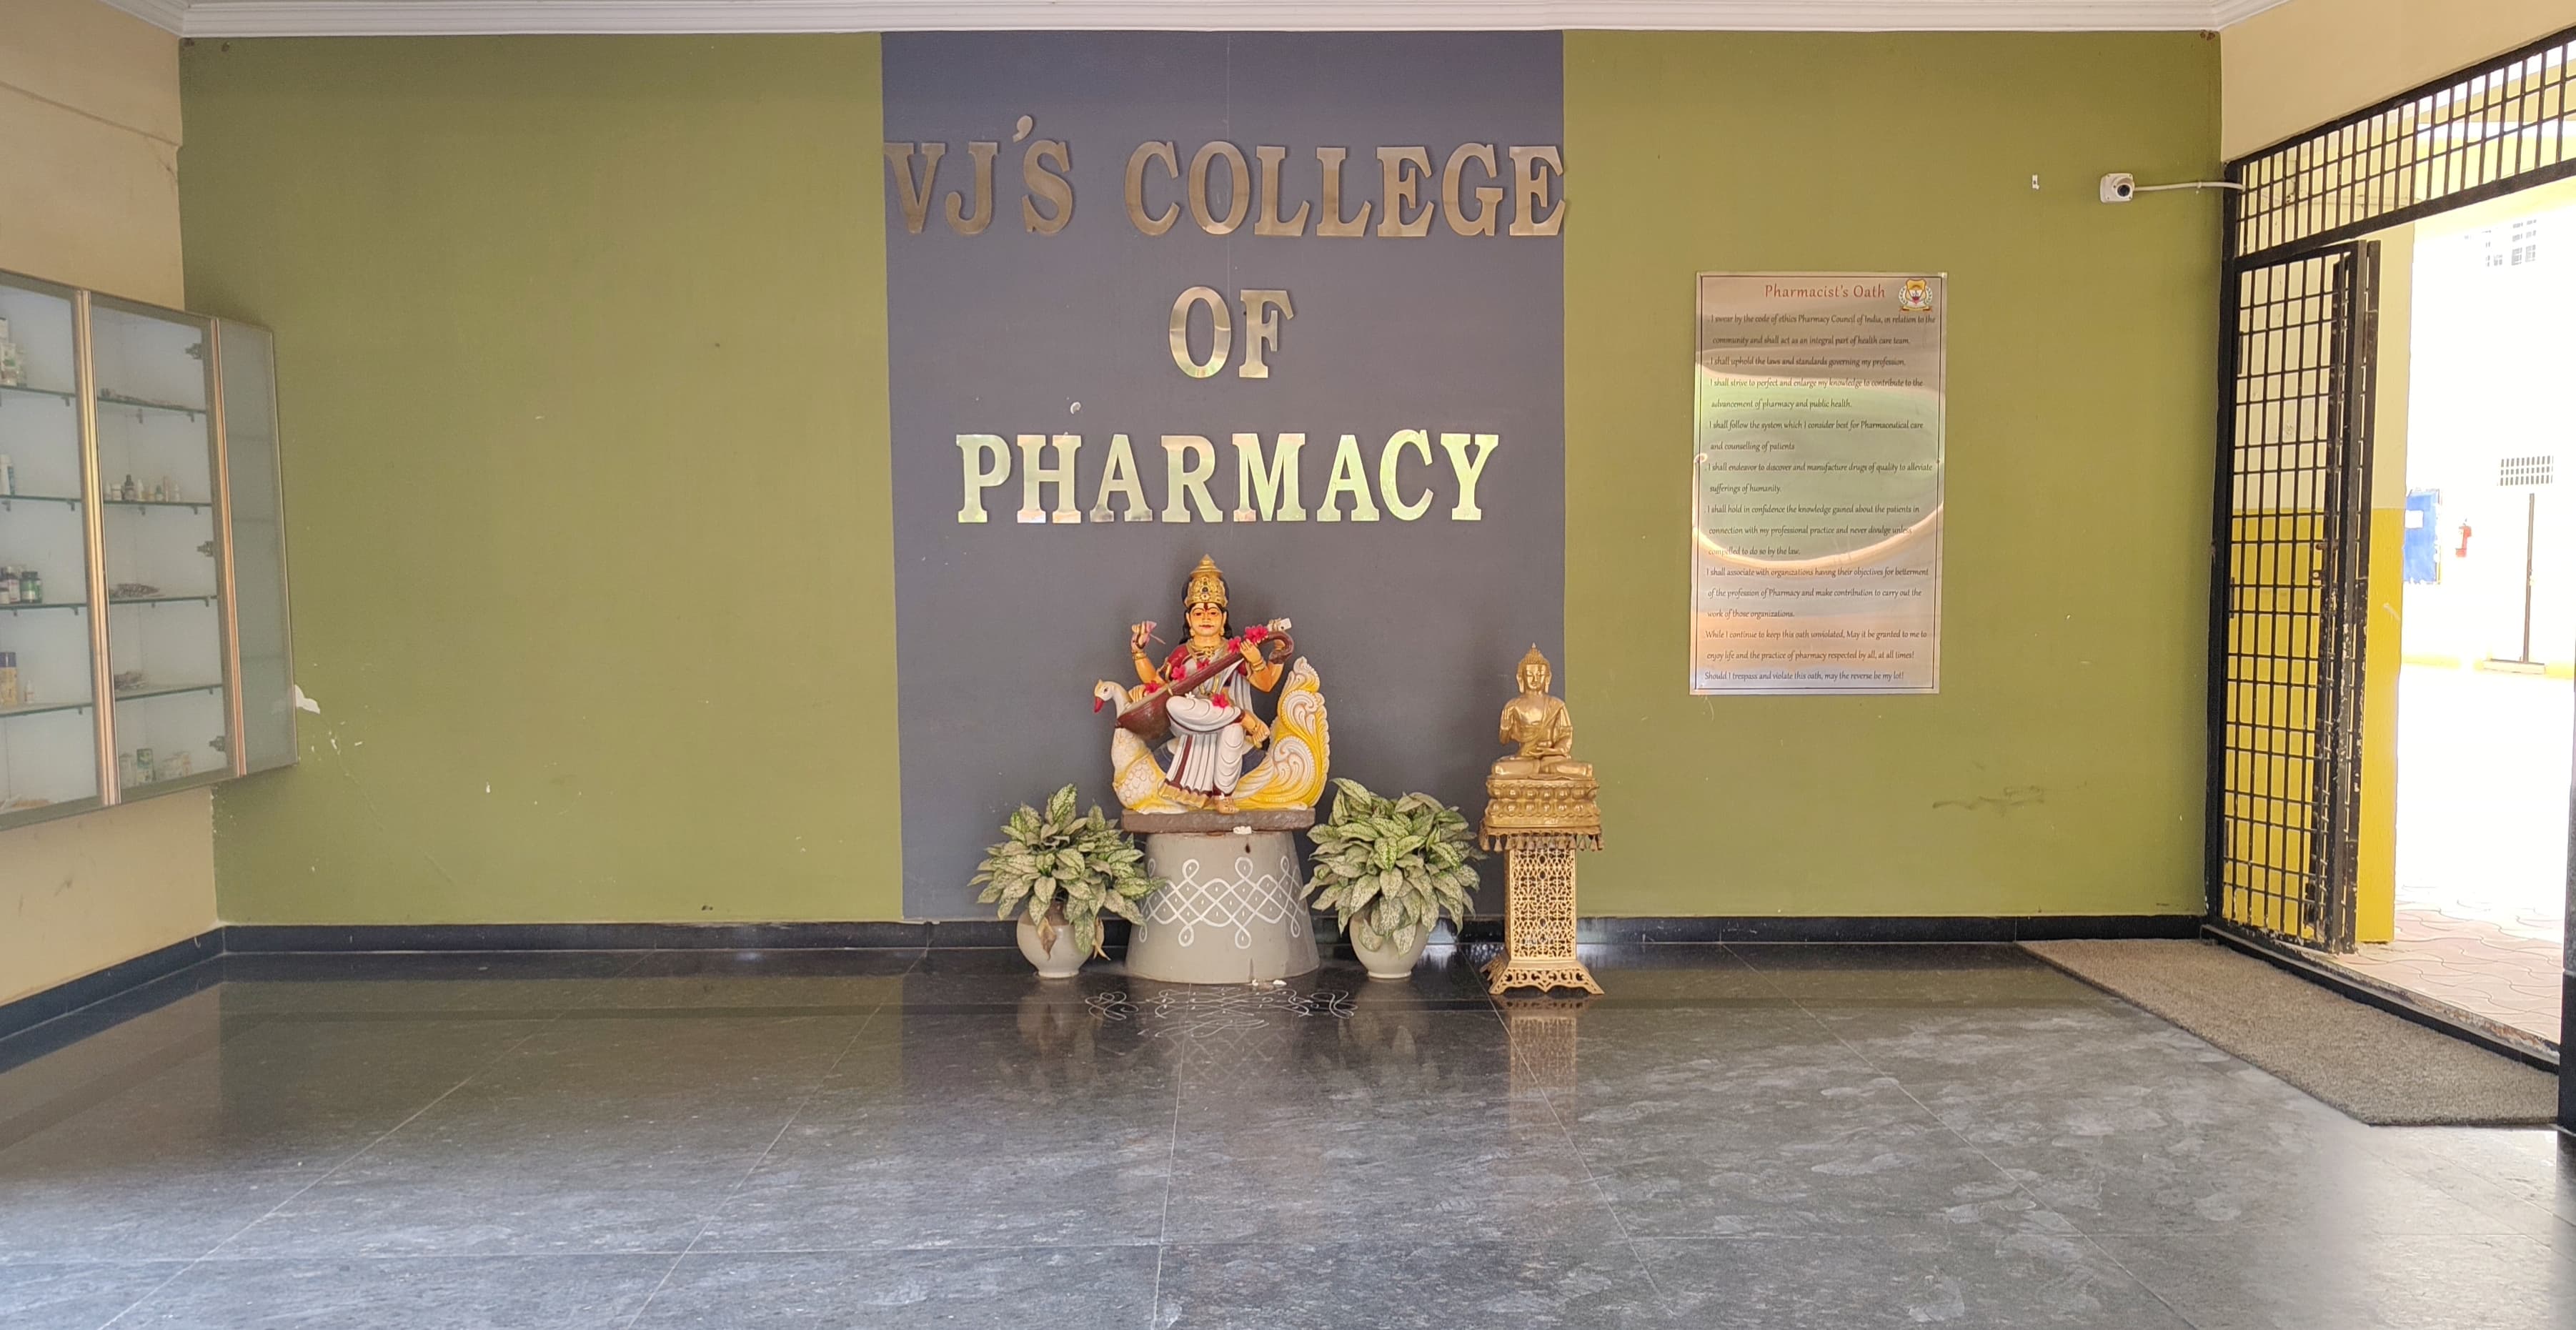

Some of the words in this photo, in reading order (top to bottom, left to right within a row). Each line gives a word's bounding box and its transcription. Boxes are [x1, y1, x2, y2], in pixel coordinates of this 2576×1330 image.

[884, 114, 1074, 237] VJ'S
[1124, 141, 1566, 237] COLLEGE
[1765, 283, 1849, 298] Pharmacist's
[1853, 283, 1886, 298] Oath
[1744, 314, 1754, 323] the
[1755, 314, 1770, 323] code
[1779, 314, 1797, 323] ethics
[1798, 314, 1830, 326] Pharmacy
[1831, 314, 1856, 323] Council
[1892, 314, 1916, 323] relation
[1925, 314, 1935, 323] the
[1168, 286, 1294, 379] OF
[1712, 336, 1749, 347] community
[1750, 334, 1763, 344] and
[1764, 334, 1779, 344] shall
[1809, 334, 1834, 347] integral
[1835, 336, 1849, 347] part
[1858, 334, 1878, 344] health
[1715, 356, 1729, 365] shall
[1731, 356, 1754, 367] uphold
[1755, 356, 1765, 365] the
[1766, 356, 1781, 365] laws
[1782, 356, 1794, 365] and
[1796, 356, 1828, 365] standards
[1829, 357, 1860, 367] governing
[1861, 359, 1871, 367] my
[1714, 377, 1729, 387] shall
[1756, 377, 1779, 389] perfect
[1779, 377, 1792, 387] and
[1794, 377, 1817, 389] enlarge
[1818, 380, 1828, 389] my
[1829, 377, 1863, 389] knowledge
[1871, 377, 1904, 387] contribute
[1912, 377, 1924, 387] the
[1711, 399, 1754, 407] advancement
[1762, 399, 1794, 410] pharmacy
[1795, 399, 1809, 407] and
[1809, 399, 1830, 410] public
[1713, 420, 1729, 429] shall
[1728, 420, 1749, 432] follow
[1749, 420, 1760, 429] the
[1761, 420, 1783, 432] system
[1784, 420, 1803, 429] which
[1807, 420, 1834, 429] consider
[1836, 420, 1849, 429] best
[1848, 420, 1859, 432] for
[1861, 420, 1909, 429] Pharmaceutical
[1710, 441, 1723, 450] and
[1724, 441, 1760, 453] counselling
[1712, 462, 1727, 471] shall
[1728, 462, 1757, 471] endeavor
[1766, 462, 1792, 471] discover
[1793, 462, 1806, 471] and
[1806, 462, 1847, 474] manufacture
[1849, 462, 1867, 474] drugs
[1876, 462, 1899, 474] quality
[1906, 462, 1932, 471] alleviate
[955, 430, 1499, 523] PHARMACY
[1709, 483, 1741, 495] sufferings
[1749, 483, 1781, 495] humanity.
[1711, 505, 1726, 513] shall
[1728, 505, 1742, 513] hold
[1751, 505, 1785, 516] confidence
[1786, 505, 1797, 513] the
[1798, 505, 1831, 516] knowledge
[1832, 505, 1854, 516] gained
[1855, 505, 1873, 513] about
[1874, 505, 1885, 513] the
[1886, 505, 1911, 516] patients
[1709, 526, 1743, 535] connection
[1744, 525, 1759, 535] with
[1759, 527, 1770, 537] my
[1771, 525, 1809, 537] professional
[1809, 526, 1835, 537] practice
[1836, 525, 1849, 535] and
[1868, 525, 1891, 537] divulge
[1776, 546, 1786, 555] the
[1788, 546, 1801, 555] law.
[1711, 567, 1726, 576] shall
[1755, 567, 1770, 576] with
[1771, 568, 1814, 578] organizations
[1815, 567, 1836, 578] having
[1837, 567, 1853, 576] their
[1854, 567, 1884, 578] objectives
[1884, 567, 1894, 578] for
[1895, 567, 1929, 576] betterment
[1716, 588, 1727, 597] the
[1728, 588, 1759, 600] profession
[1761, 588, 1769, 600] of
[1769, 588, 1801, 600] Pharmacy
[1801, 588, 1815, 597] and
[1815, 588, 1833, 597] make
[1834, 588, 1874, 597] contribution
[1882, 590, 1899, 600] carry
[1911, 588, 1922, 597] the
[1707, 609, 1724, 617] work
[1724, 609, 1733, 620] of
[1732, 609, 1749, 617] those
[1750, 610, 1795, 620] organizations.
[1706, 630, 1724, 638] While
[1766, 630, 1781, 640] keep
[1782, 630, 1794, 638] this
[1795, 630, 1809, 638] oath
[1846, 630, 1860, 640] May
[1867, 630, 1875, 638] be
[1876, 630, 1901, 640] granted
[1706, 653, 1724, 662] enjoy
[1725, 650, 1736, 662] life
[1736, 650, 1749, 659] and
[1750, 650, 1761, 659] the
[1761, 652, 1786, 662] practice
[1786, 650, 1795, 662] of
[1795, 650, 1826, 662] pharmacy
[1828, 650, 1857, 662] respected
[1859, 650, 1866, 662] by
[1895, 650, 1914, 659] times!
[1705, 671, 1727, 680] Should
[1732, 672, 1758, 682] trespass
[1759, 671, 1771, 680] and
[1772, 671, 1793, 680] violate
[1794, 671, 1806, 680] this
[1824, 673, 1838, 682] may
[1839, 671, 1849, 680] the
[1874, 671, 1881, 680] be
[1882, 673, 1893, 682] my
